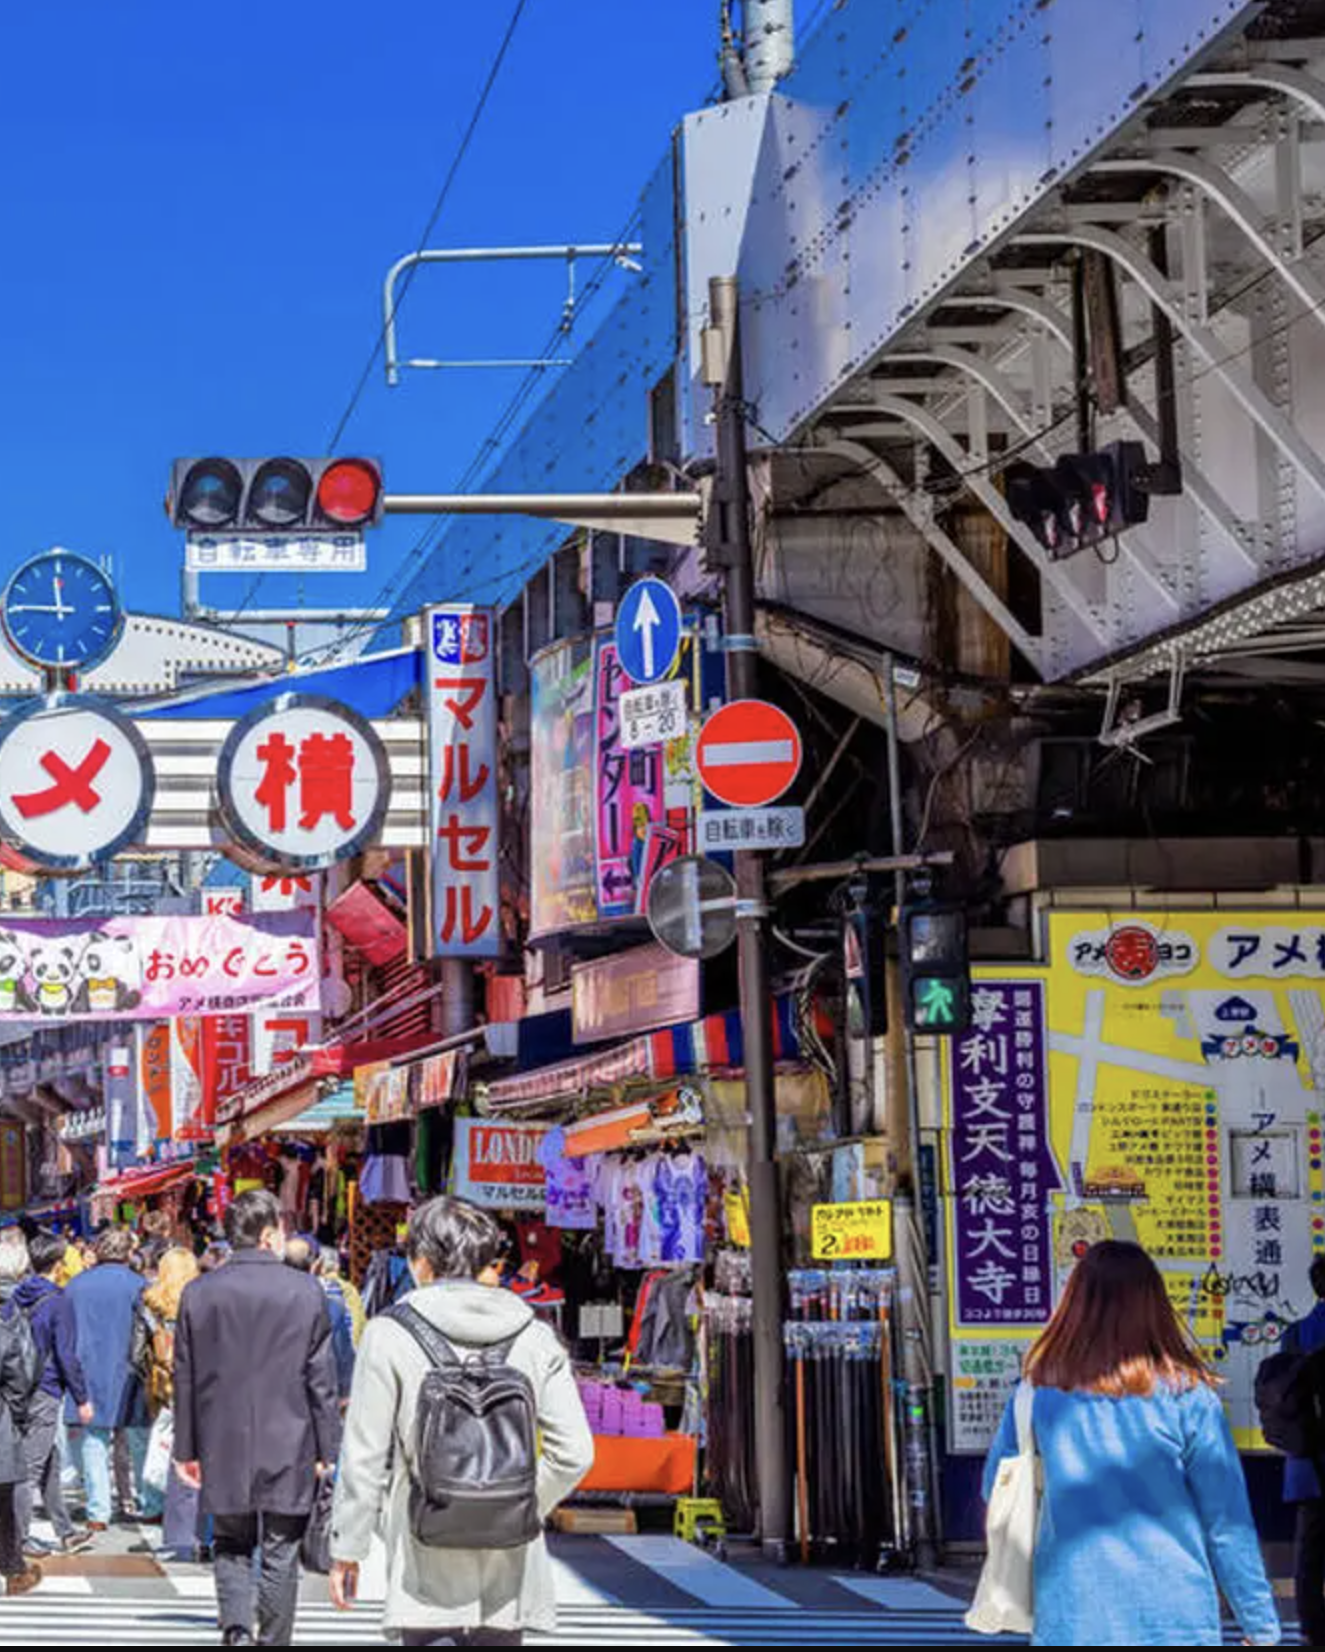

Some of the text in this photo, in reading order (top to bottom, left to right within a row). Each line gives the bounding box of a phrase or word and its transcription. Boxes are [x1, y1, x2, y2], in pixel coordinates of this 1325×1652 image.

[197, 537, 358, 562] 自転車専用
[435, 677, 493, 944] マルセル
[1226, 934, 1325, 969] アメ
